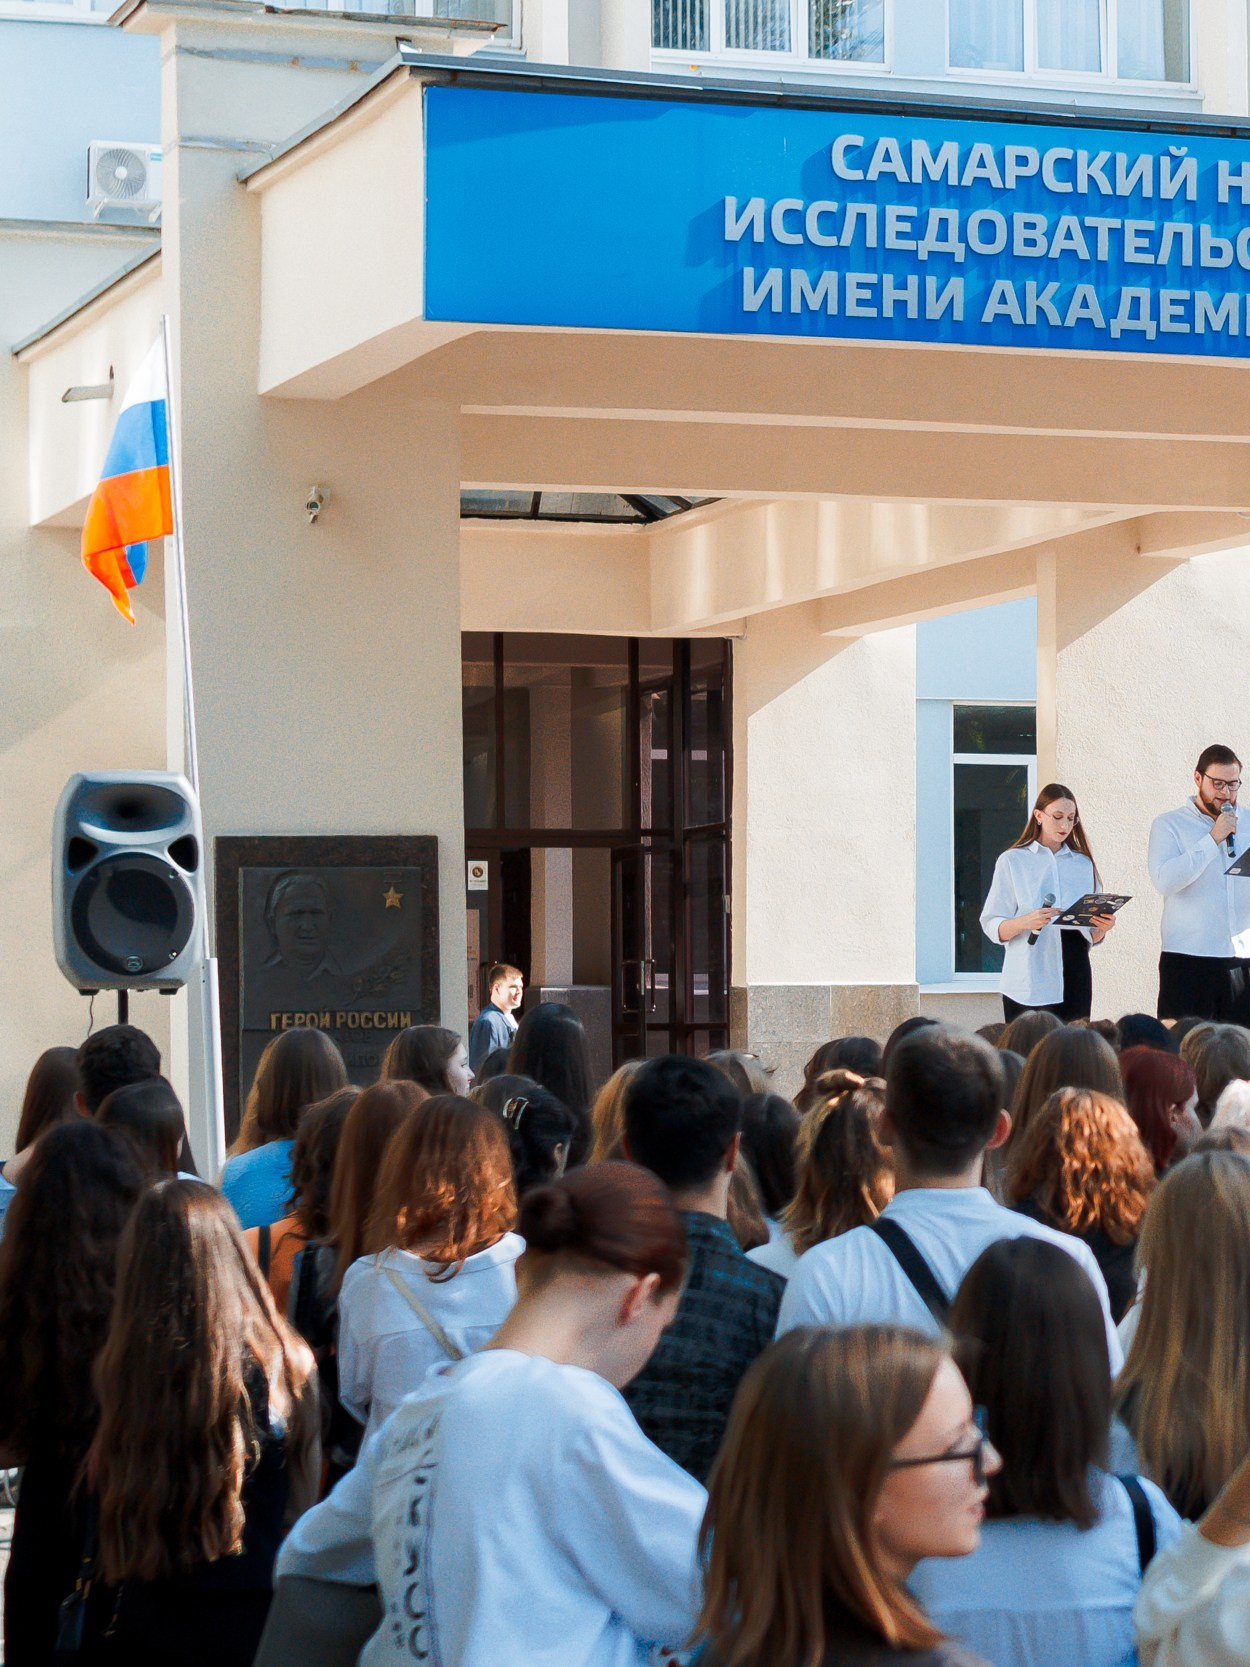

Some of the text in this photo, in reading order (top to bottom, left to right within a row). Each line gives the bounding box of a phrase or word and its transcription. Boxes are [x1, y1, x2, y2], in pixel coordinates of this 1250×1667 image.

[831, 133, 1197, 201] САМАРСКИЙ
[742, 266, 964, 321] ИМЕНИ
[336, 1011, 412, 1029] РОССИИ
